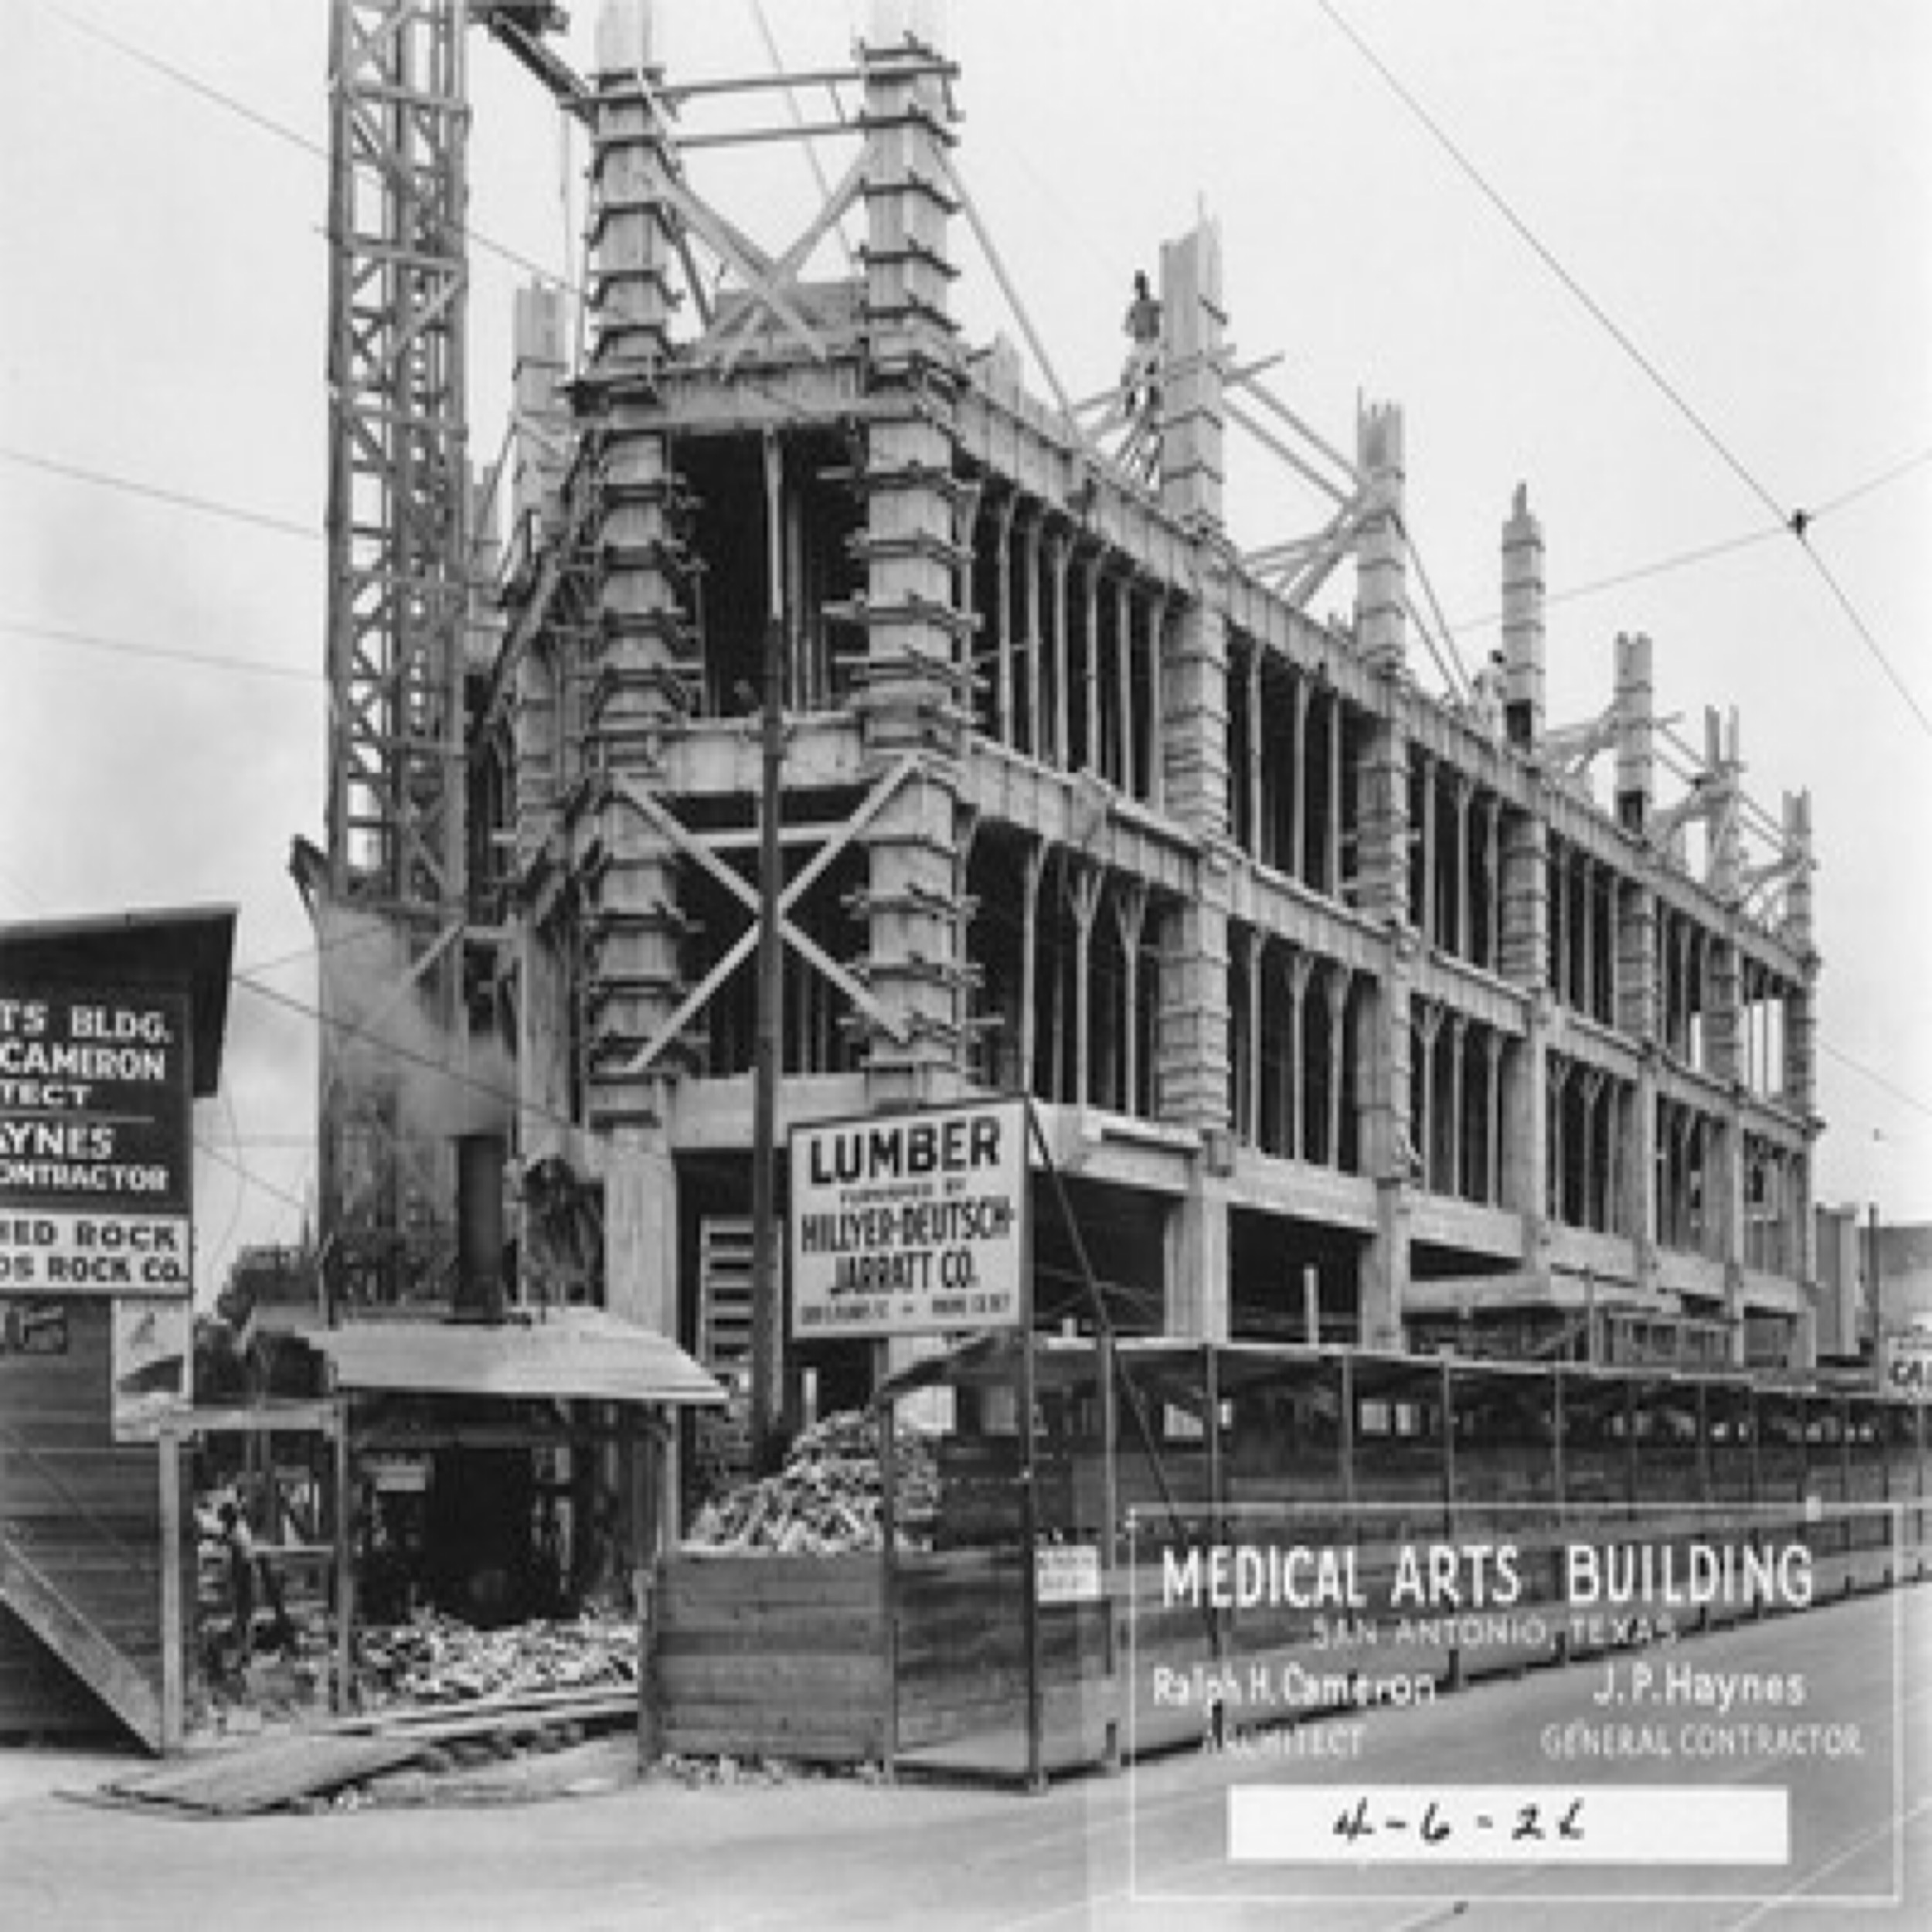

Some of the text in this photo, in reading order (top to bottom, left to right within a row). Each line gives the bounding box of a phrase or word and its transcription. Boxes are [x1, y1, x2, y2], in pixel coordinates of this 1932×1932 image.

[70, 1005, 175, 1043] BLDG.
[811, 1116, 1001, 1185] LUMBER
[76, 1220, 179, 1252] ROCK
[47, 1256, 131, 1283] ROCK
